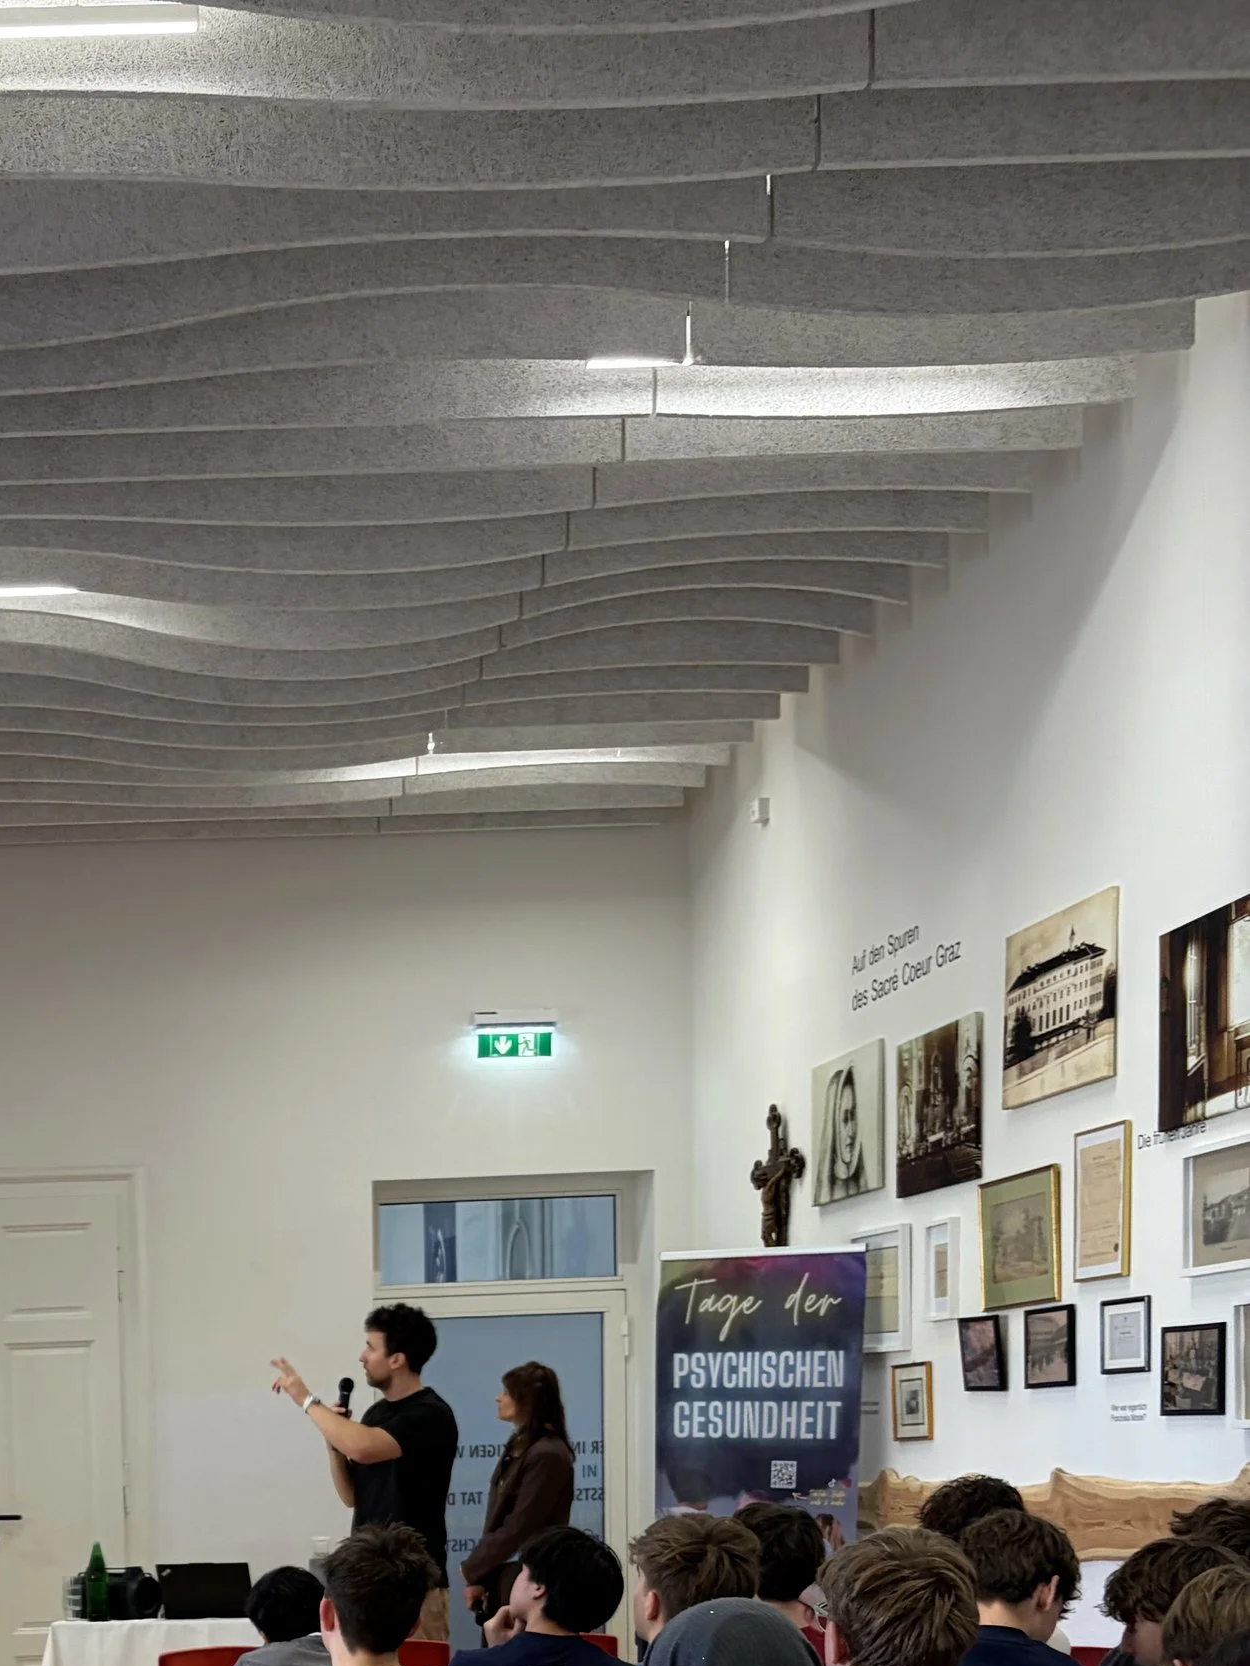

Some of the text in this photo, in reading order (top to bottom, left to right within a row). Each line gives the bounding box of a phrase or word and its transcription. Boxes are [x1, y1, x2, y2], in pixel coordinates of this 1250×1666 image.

[852, 925, 919, 975] Auf den Spuren
[852, 941, 961, 1011] des Sacré Coeur Graz
[1137, 1134, 1151, 1149] Die
[674, 1272, 842, 1342] Tage der
[673, 1350, 845, 1388] PSYCHISCHEN
[673, 1400, 842, 1440] GESUNDHEIT
